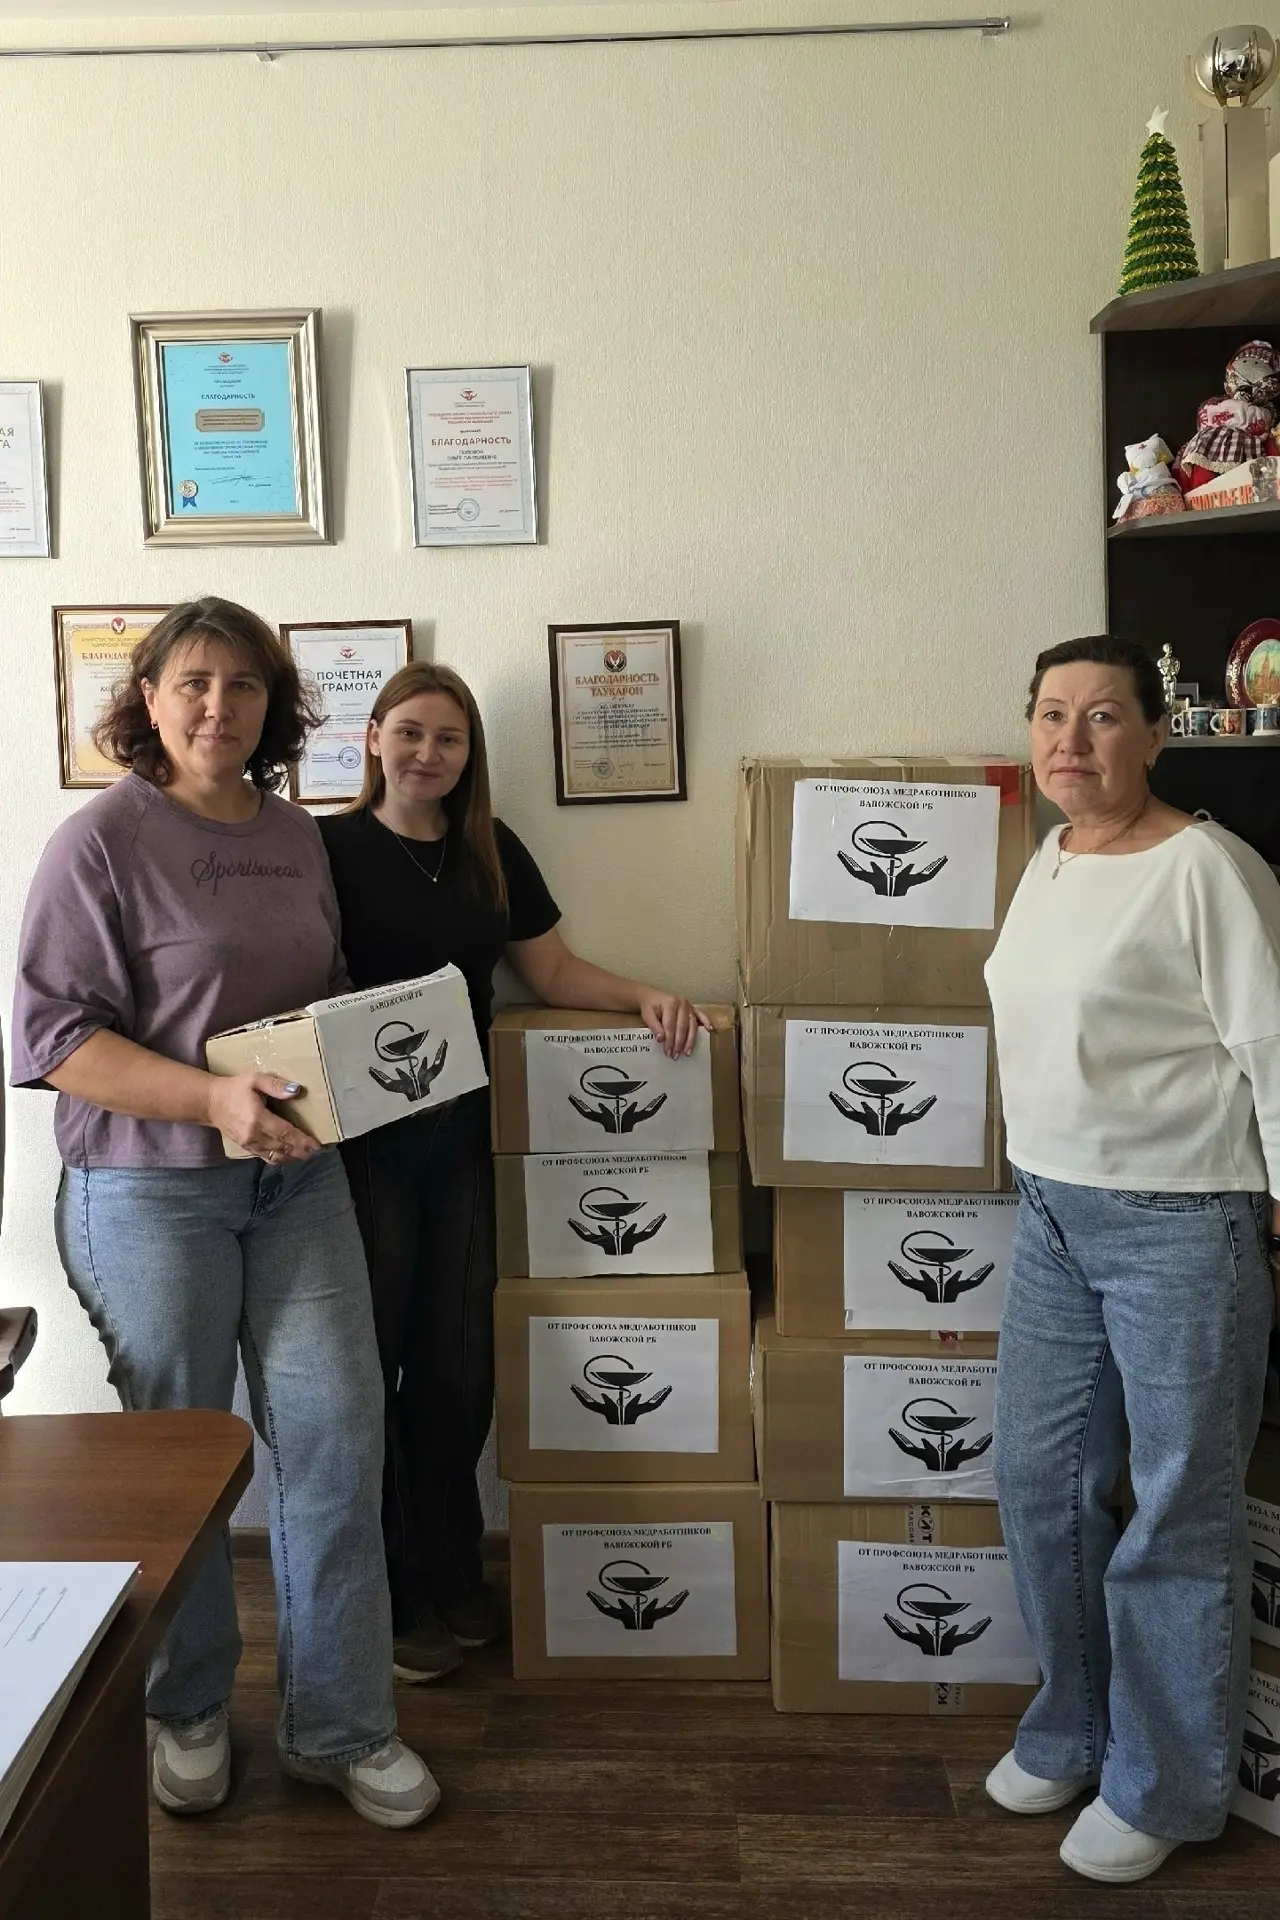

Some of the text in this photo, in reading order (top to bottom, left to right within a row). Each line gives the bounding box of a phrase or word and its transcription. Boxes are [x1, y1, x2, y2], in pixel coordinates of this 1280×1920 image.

[201, 393, 256, 401] БЛАГОДАРНОСТЬ
[431, 436, 512, 447] БЛАГОДАРНОСТЬ
[316, 669, 382, 681] ПОЧЕТНАЯ
[575, 672, 660, 685] БЛАГОДАРНОСТЬ
[322, 682, 379, 692] ГРАМОТА
[815, 784, 977, 799] ОТ ПРОФСОЮЗА МЕДРАБОТНИКОВ
[859, 799, 934, 810] ВАВОЖСКОЙ РБ
[190, 850, 303, 895] Sportswear
[370, 991, 414, 1012] ВАВОЖСКОЙ
[805, 1027, 965, 1039] ОТ ПРОФСОЮЗА МЕДРАБОТНИКОВ
[557, 1034, 612, 1043] ПРОФСОЮЗА
[584, 1044, 638, 1054] ВАВОЖСКОЙ
[849, 1040, 922, 1051] ВАВОЖСКОЙ РБ
[542, 1154, 687, 1167] ОТ ПРОФСОЮЗА МЕДРАБОТНИКОВ
[583, 1165, 637, 1176] ВАВОЖСКОЙ
[878, 1198, 936, 1206] ПРОФСОЮЗА
[907, 1209, 965, 1218] ВАВОЖСКОЙ
[547, 1322, 697, 1332] ОТ ПРОФСОЮЗА МЕДРАБОТНИКОВ
[589, 1334, 657, 1344] ВАВОЖСКОЙ РБ
[879, 1363, 938, 1373] ПРОФСОЮЗА
[908, 1377, 982, 1387] ВАВОЖСКОЙ РБ
[561, 1528, 711, 1537] ОТ ПРОФСОЮЗА МЕДРАБОТНИКОВ
[604, 1540, 673, 1549] ВАВОЖСКОЙ РБ
[858, 1549, 872, 1557] ОТ
[873, 1549, 933, 1559] ПРОФСОЮЗА
[903, 1562, 975, 1573] ВАВОЖСКОЙ РБ
